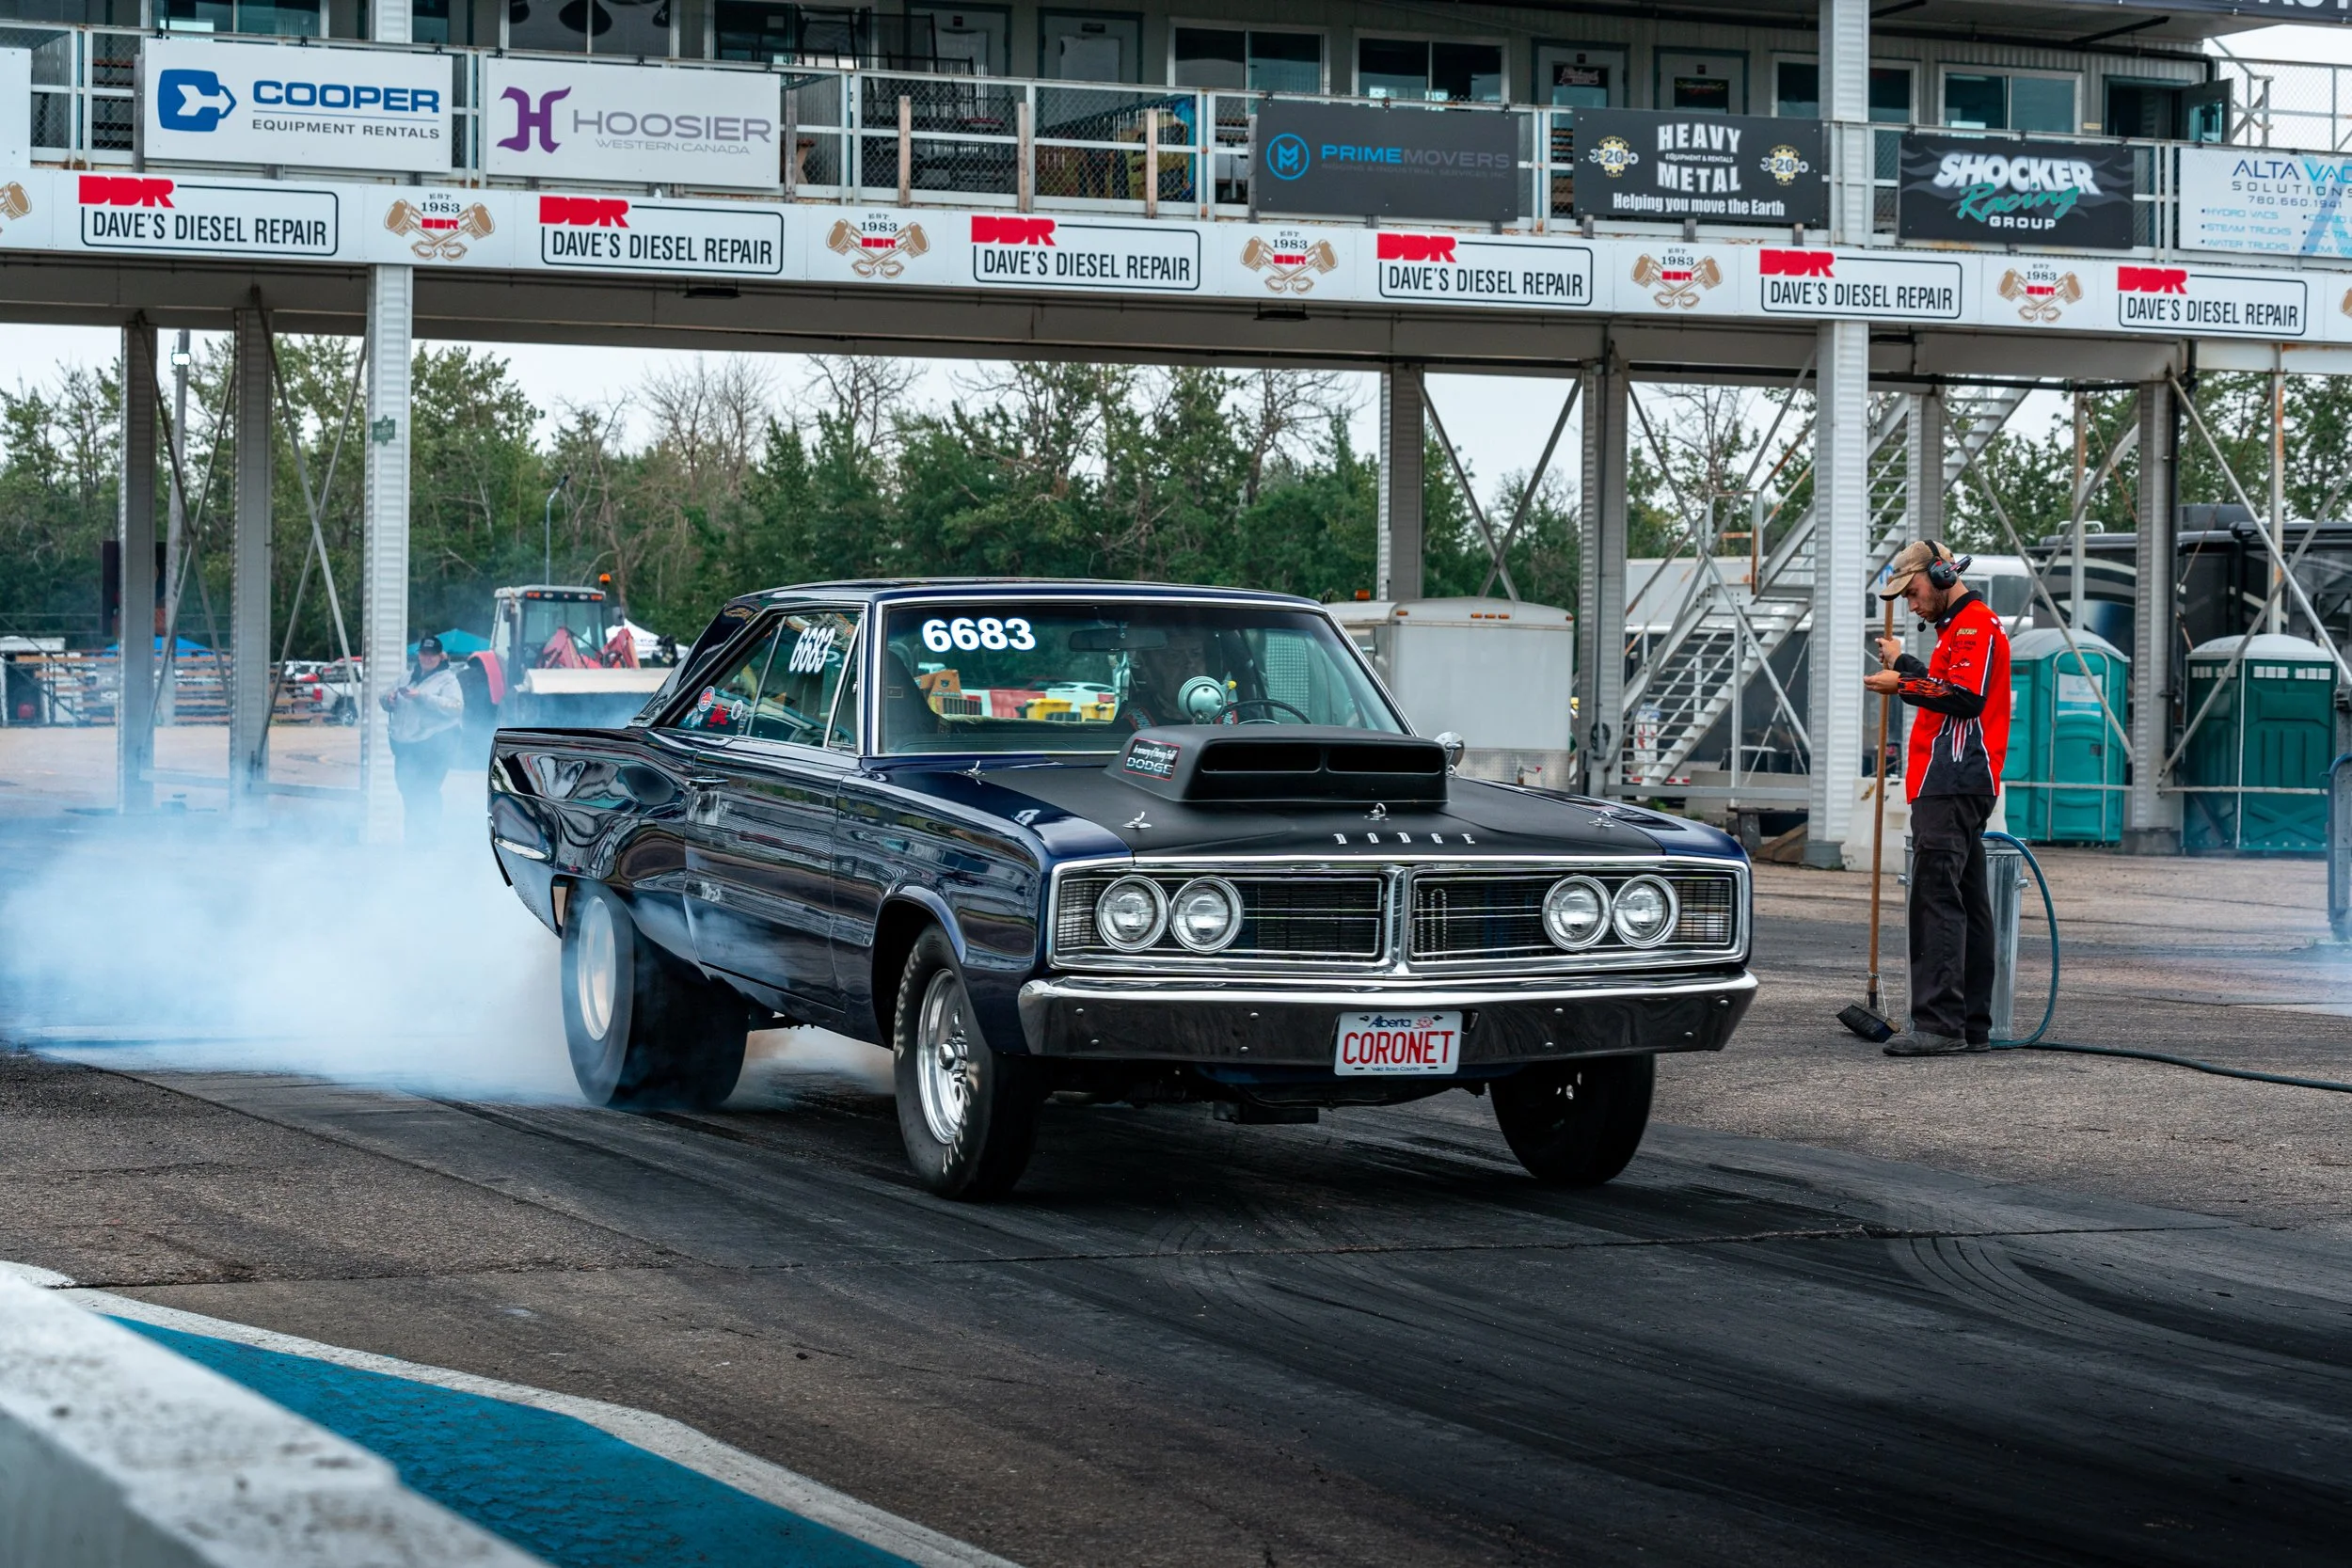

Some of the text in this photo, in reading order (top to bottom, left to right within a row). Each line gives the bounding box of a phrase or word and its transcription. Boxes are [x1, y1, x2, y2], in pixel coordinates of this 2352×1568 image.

[252, 80, 440, 113] COOPER
[252, 119, 440, 140] EQUIPMENT RENTALS
[573, 109, 771, 143] HOOSIER
[1657, 122, 1742, 154] HEAVY
[595, 138, 751, 155] WESTERN CANADA
[1604, 150, 1624, 164] 20
[1665, 152, 1701, 162] EQUIPMENT
[1657, 161, 1741, 194] METAL
[1776, 159, 1794, 172] 20
[1933, 152, 2104, 196] SHOCKER
[2233, 159, 2300, 180] ALTA
[79, 175, 175, 208] DDR
[1613, 192, 1785, 216] Helping you move the Earth
[1957, 182, 2080, 222] Racing
[2248, 196, 2343, 209] 780.660.1941
[421, 201, 461, 213] 1983
[539, 196, 629, 229] DDR
[2206, 209, 2279, 220] HYDRO VACS
[93, 212, 326, 246] DAVE'S DIESEL REPAIR
[861, 221, 898, 232] 1983
[971, 216, 1057, 246] DDR
[1989, 215, 2056, 230] GROUP
[2206, 225, 2292, 235] STEAM TRUCKS
[552, 231, 772, 264] DAVE'S DIESEL REPAIR
[1273, 239, 1308, 249] 1983
[1377, 233, 1456, 262] DDR
[2206, 239, 2290, 251] WATER TRUCKS
[984, 250, 1190, 281] DAVE'S DIESEL REPAIR
[1661, 256, 1694, 266] 1983
[1759, 249, 1835, 277] DDR
[1389, 265, 1582, 297] DAVE'S DIESEL REPAIR
[2026, 271, 2058, 281] 1983
[2117, 266, 2187, 294] DDR
[1771, 281, 1953, 311] DAVE'S DIESEL REPAIR
[2127, 296, 2297, 328] DAVE'S DIESEL REPAIR
[922, 618, 1037, 653] 6683
[788, 627, 837, 674] 6683
[1126, 756, 1174, 775] DODGE
[1333, 832, 1476, 846] DODGE
[1368, 1015, 1412, 1028] Alberta
[1343, 1031, 1454, 1065] CORONET
